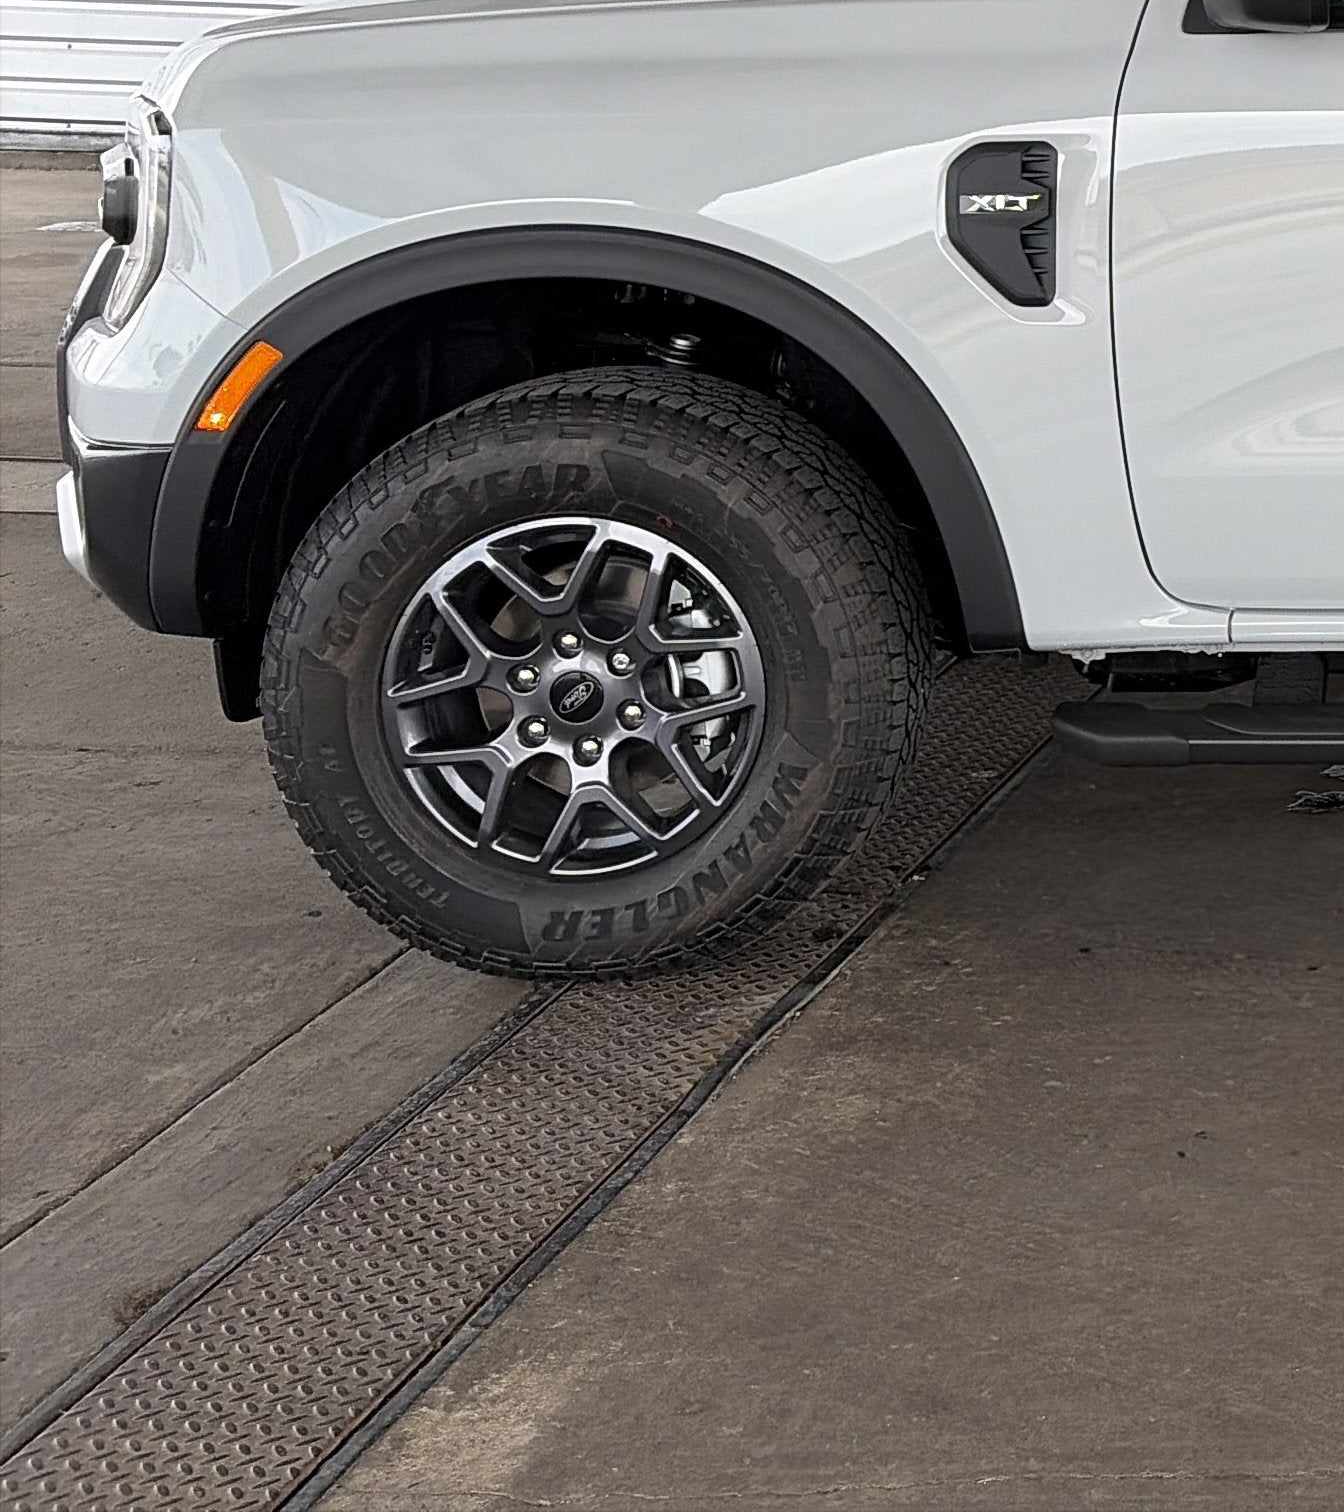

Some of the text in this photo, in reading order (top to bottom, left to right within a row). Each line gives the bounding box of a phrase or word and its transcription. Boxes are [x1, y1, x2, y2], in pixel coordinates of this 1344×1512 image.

[966, 193, 1041, 212] XLT
[562, 684, 590, 710] Ford
[541, 761, 809, 942] WRANGLER
